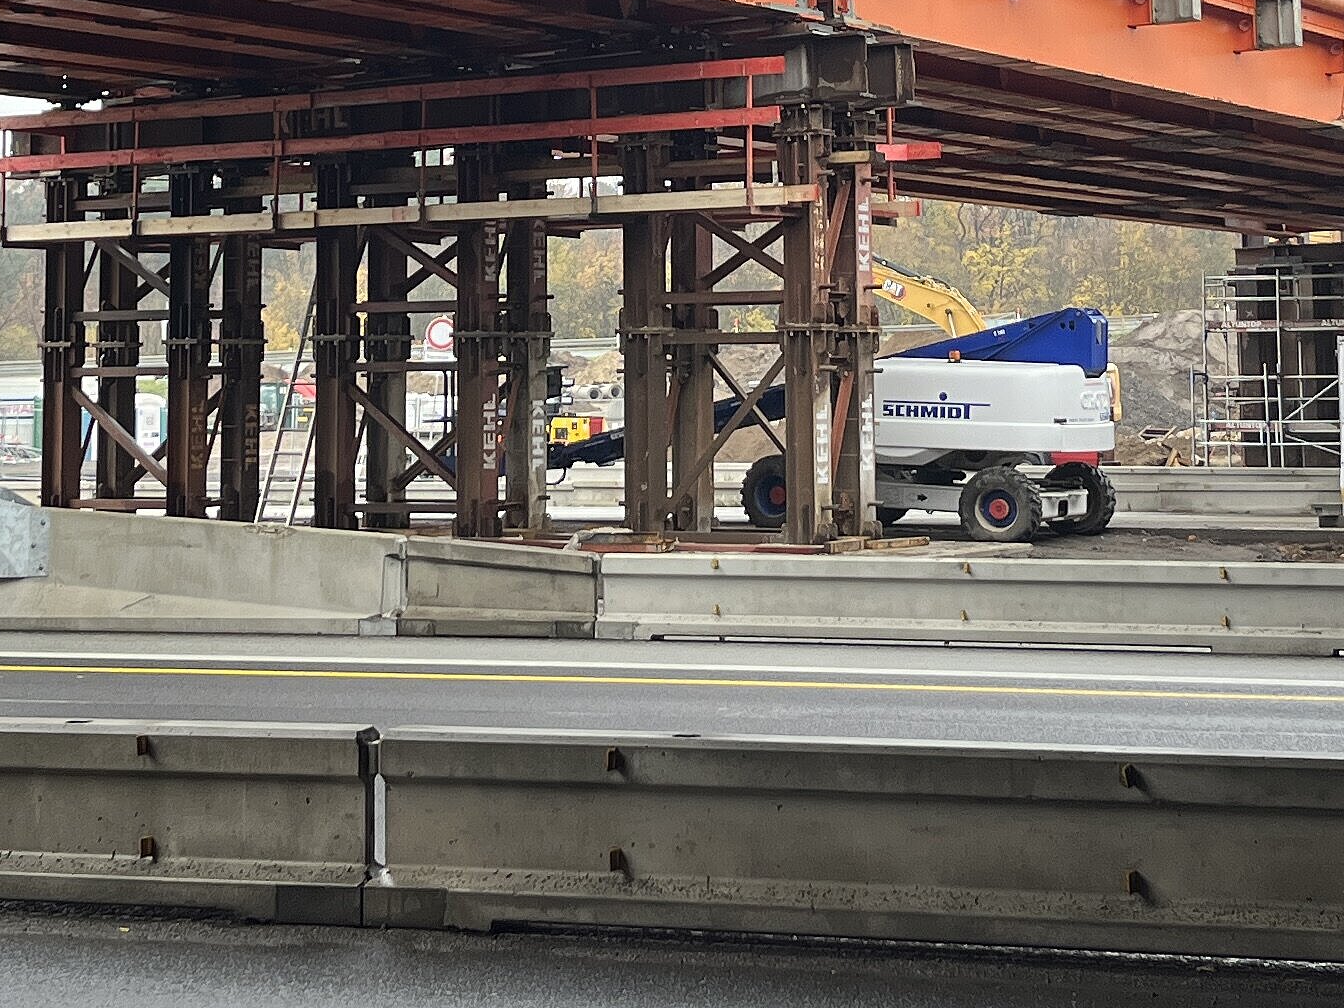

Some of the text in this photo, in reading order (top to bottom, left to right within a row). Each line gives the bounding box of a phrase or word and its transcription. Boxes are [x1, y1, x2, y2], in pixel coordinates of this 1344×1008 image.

[857, 196, 870, 272] KEHL
[1221, 320, 1262, 328] ALTUNTOP
[483, 393, 496, 470] KEHL
[532, 400, 545, 472] KEHL
[816, 403, 829, 484] KEHL
[861, 393, 873, 472] KEHL
[882, 400, 974, 420] SCHMIDT
